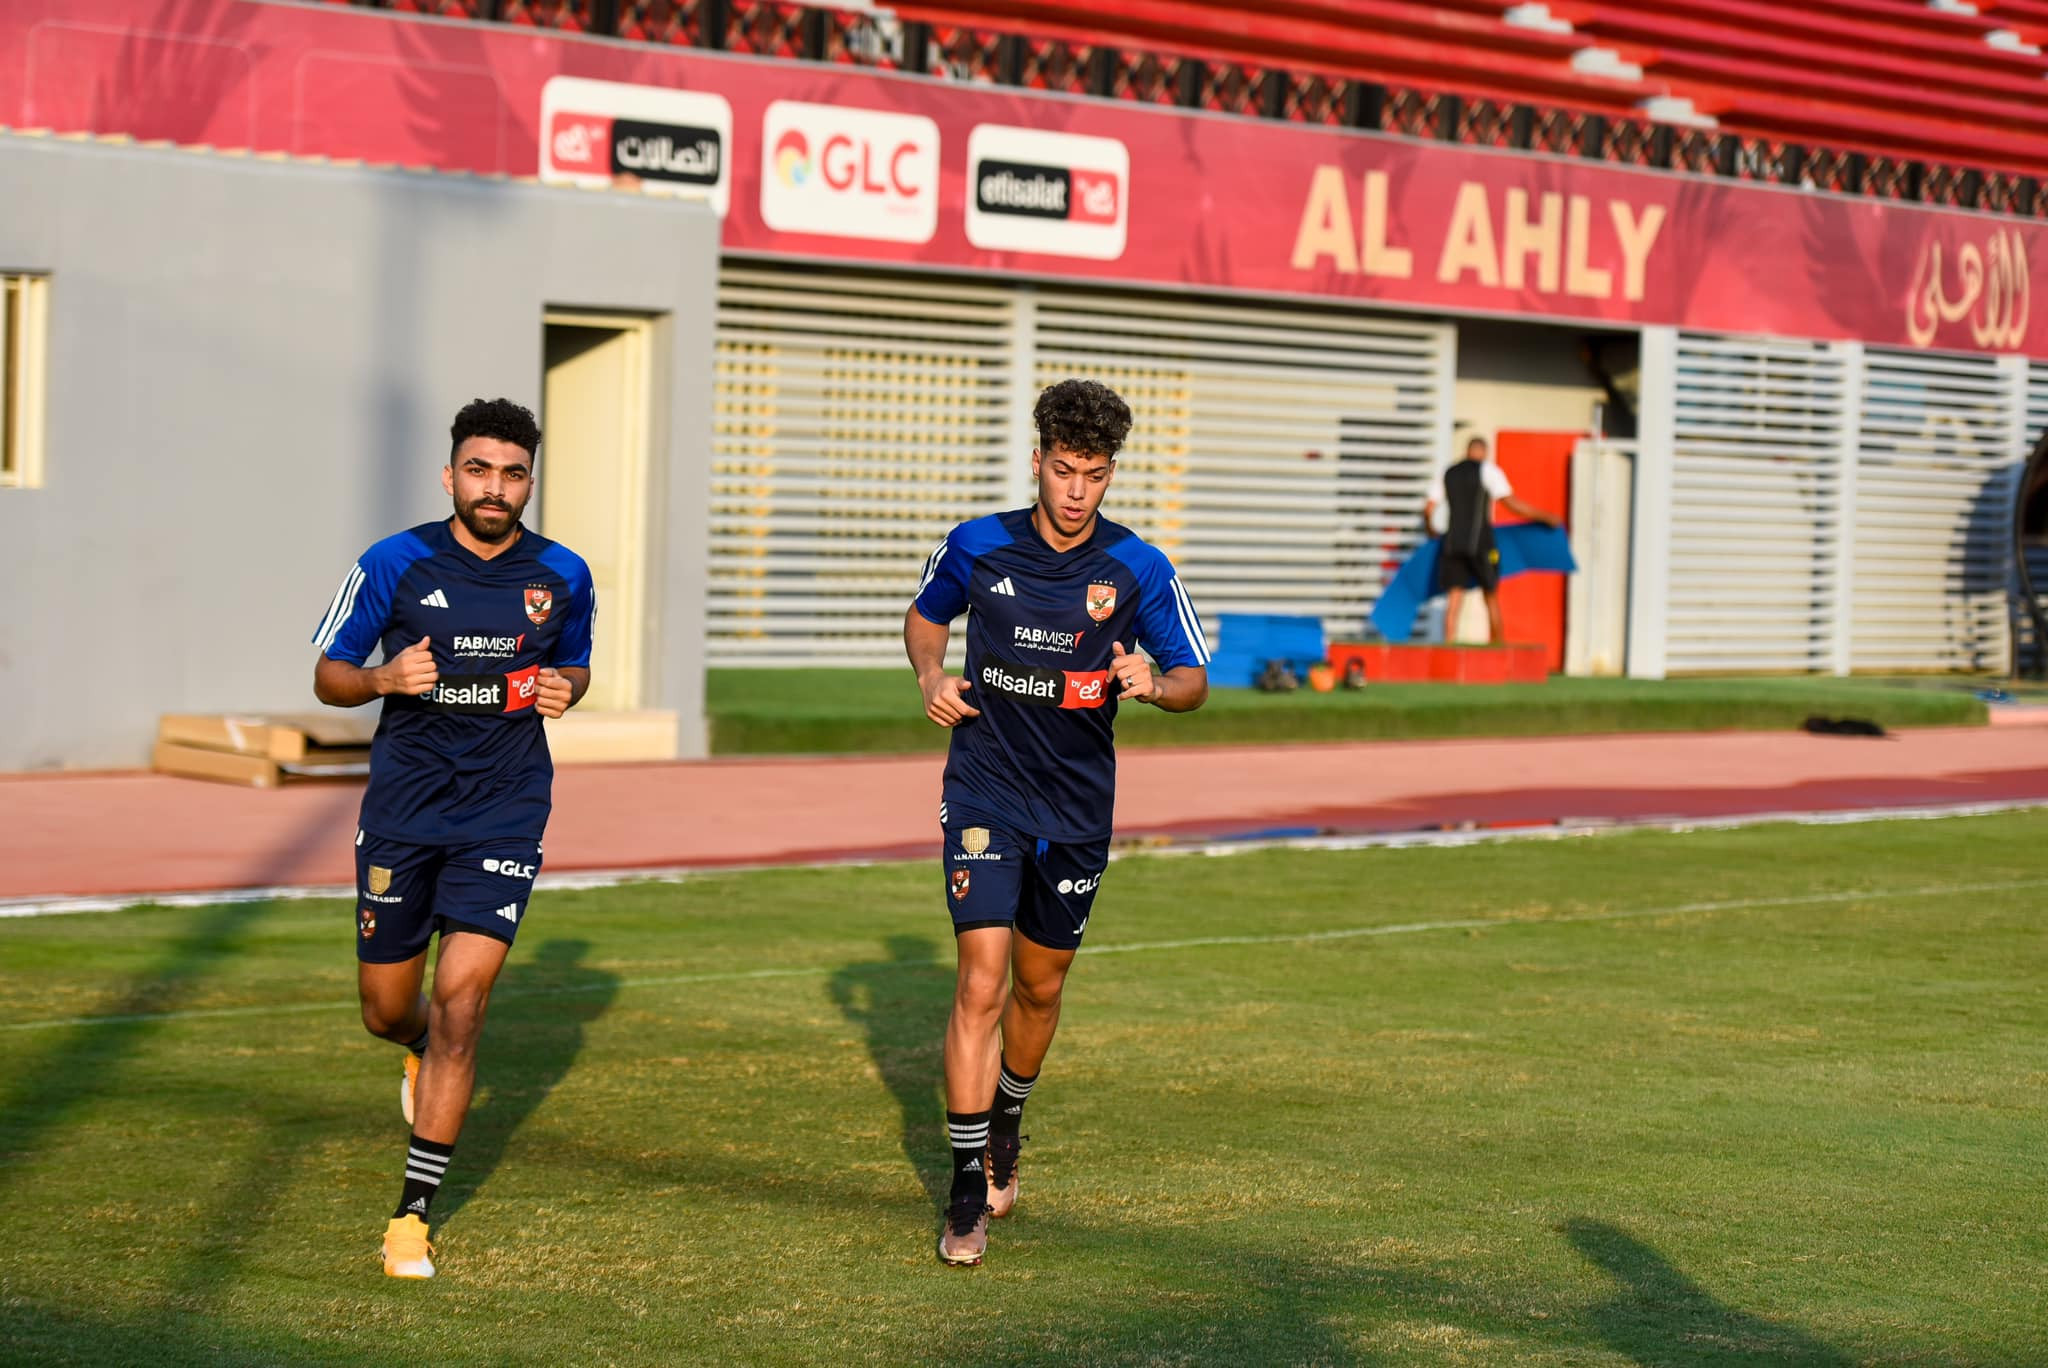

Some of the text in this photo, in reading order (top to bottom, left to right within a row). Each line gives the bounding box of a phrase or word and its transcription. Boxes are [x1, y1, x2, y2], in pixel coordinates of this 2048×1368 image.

[821, 134, 920, 199] GLC
[980, 170, 1066, 211] etisalat
[1291, 164, 1667, 302] AL AHLY
[982, 666, 1057, 698] etisalat
[1071, 679, 1081, 689] by
[499, 860, 536, 880] GLC
